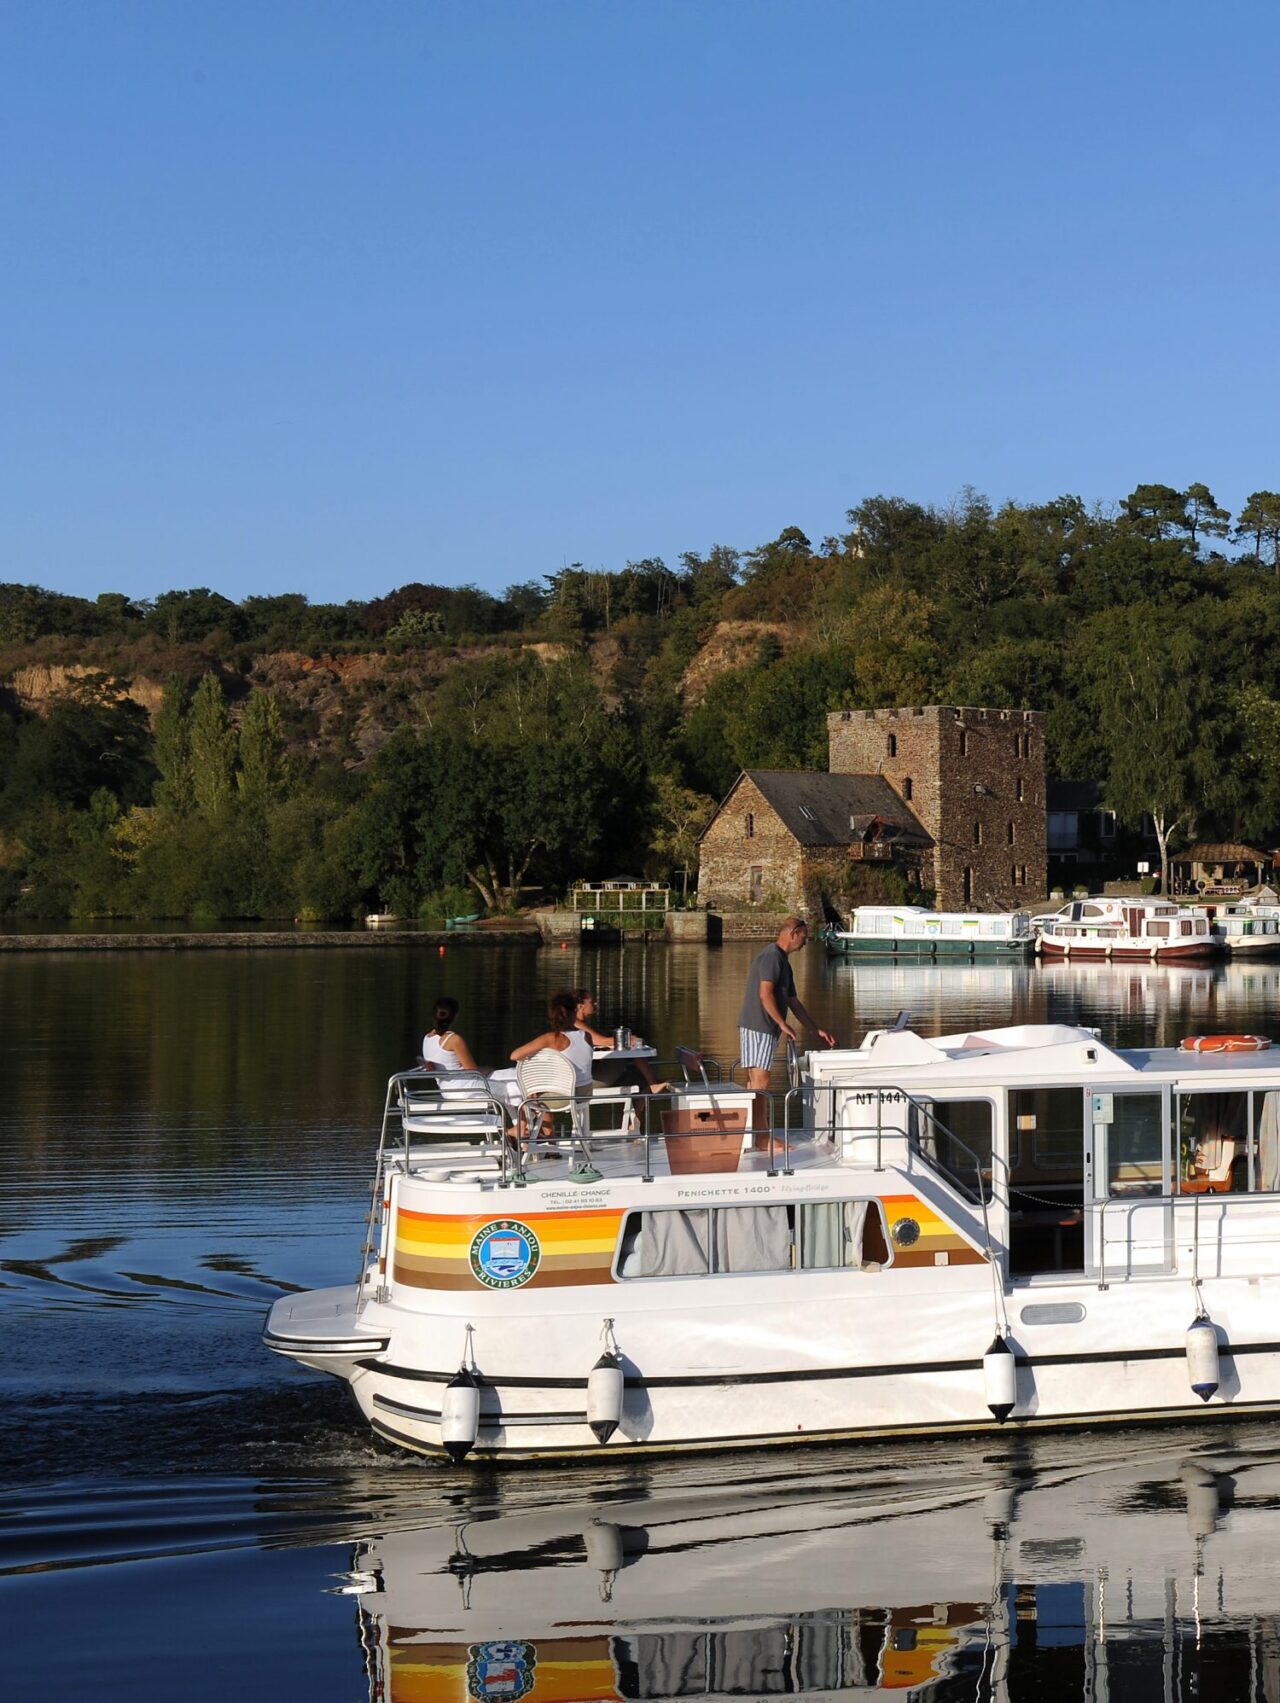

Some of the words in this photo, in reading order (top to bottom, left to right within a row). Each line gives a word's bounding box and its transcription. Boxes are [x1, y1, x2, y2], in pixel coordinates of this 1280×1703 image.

[856, 1093, 874, 1104] NT
[471, 1223, 498, 1256] MAINE
[511, 1223, 539, 1253] ANJOU
[478, 1268, 532, 1288] RIVIERES
